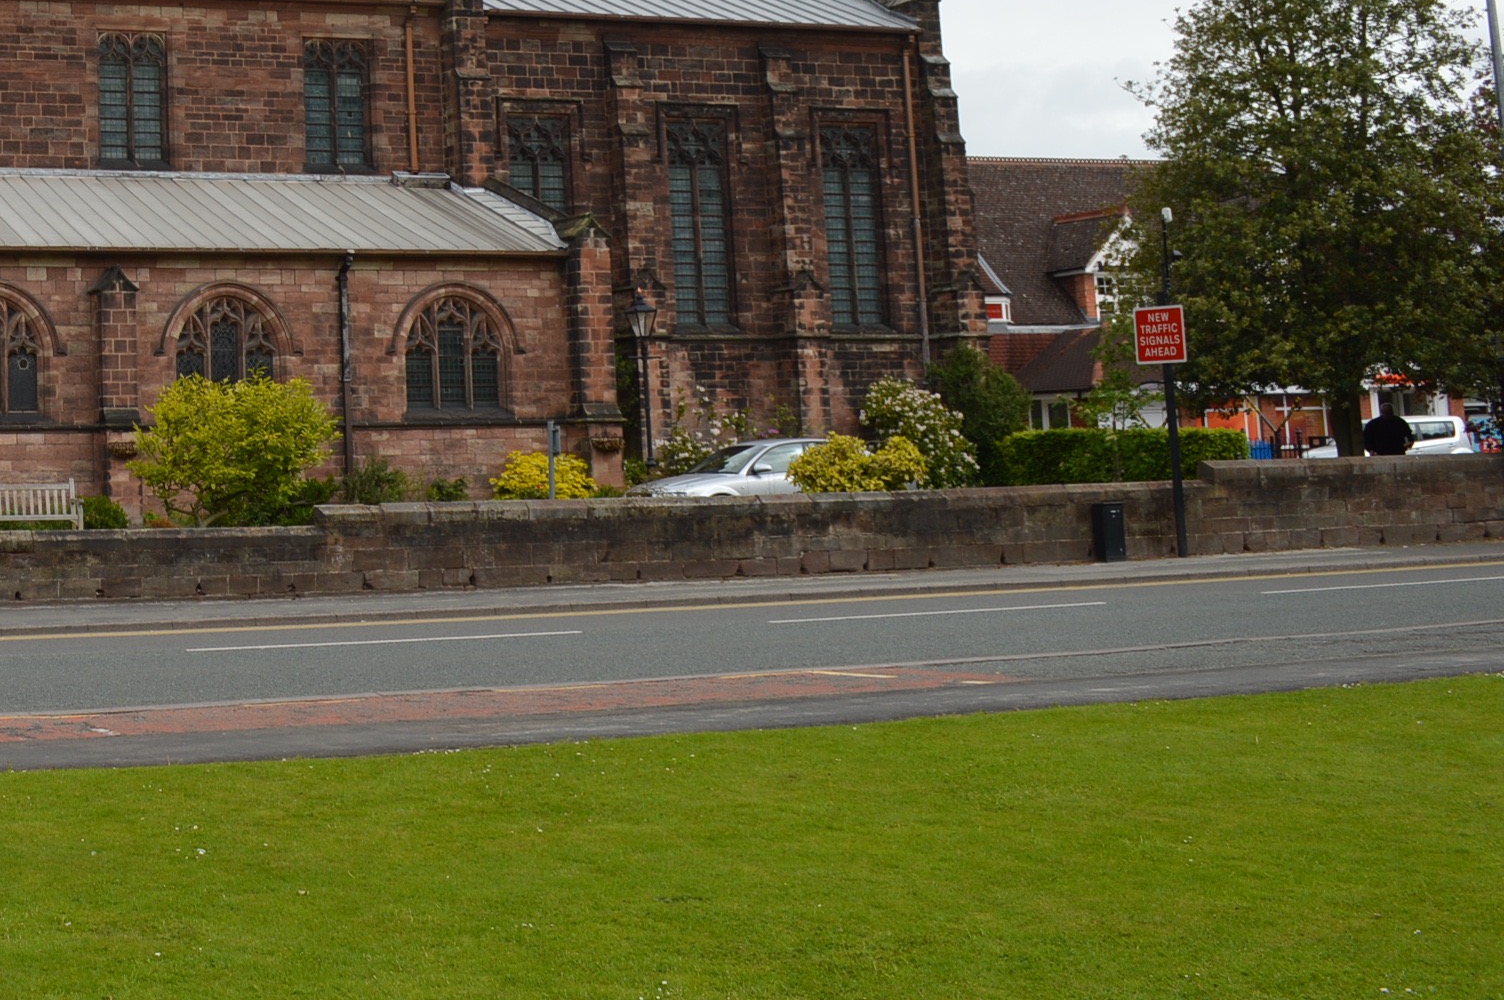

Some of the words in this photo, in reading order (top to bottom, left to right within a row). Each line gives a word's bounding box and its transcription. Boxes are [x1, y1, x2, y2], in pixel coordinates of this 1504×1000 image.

[1147, 312, 1169, 323] NEW
[1140, 323, 1178, 334] TRAFFIC
[1139, 334, 1181, 346] SIGNALS
[1144, 346, 1177, 357] AHEAD
